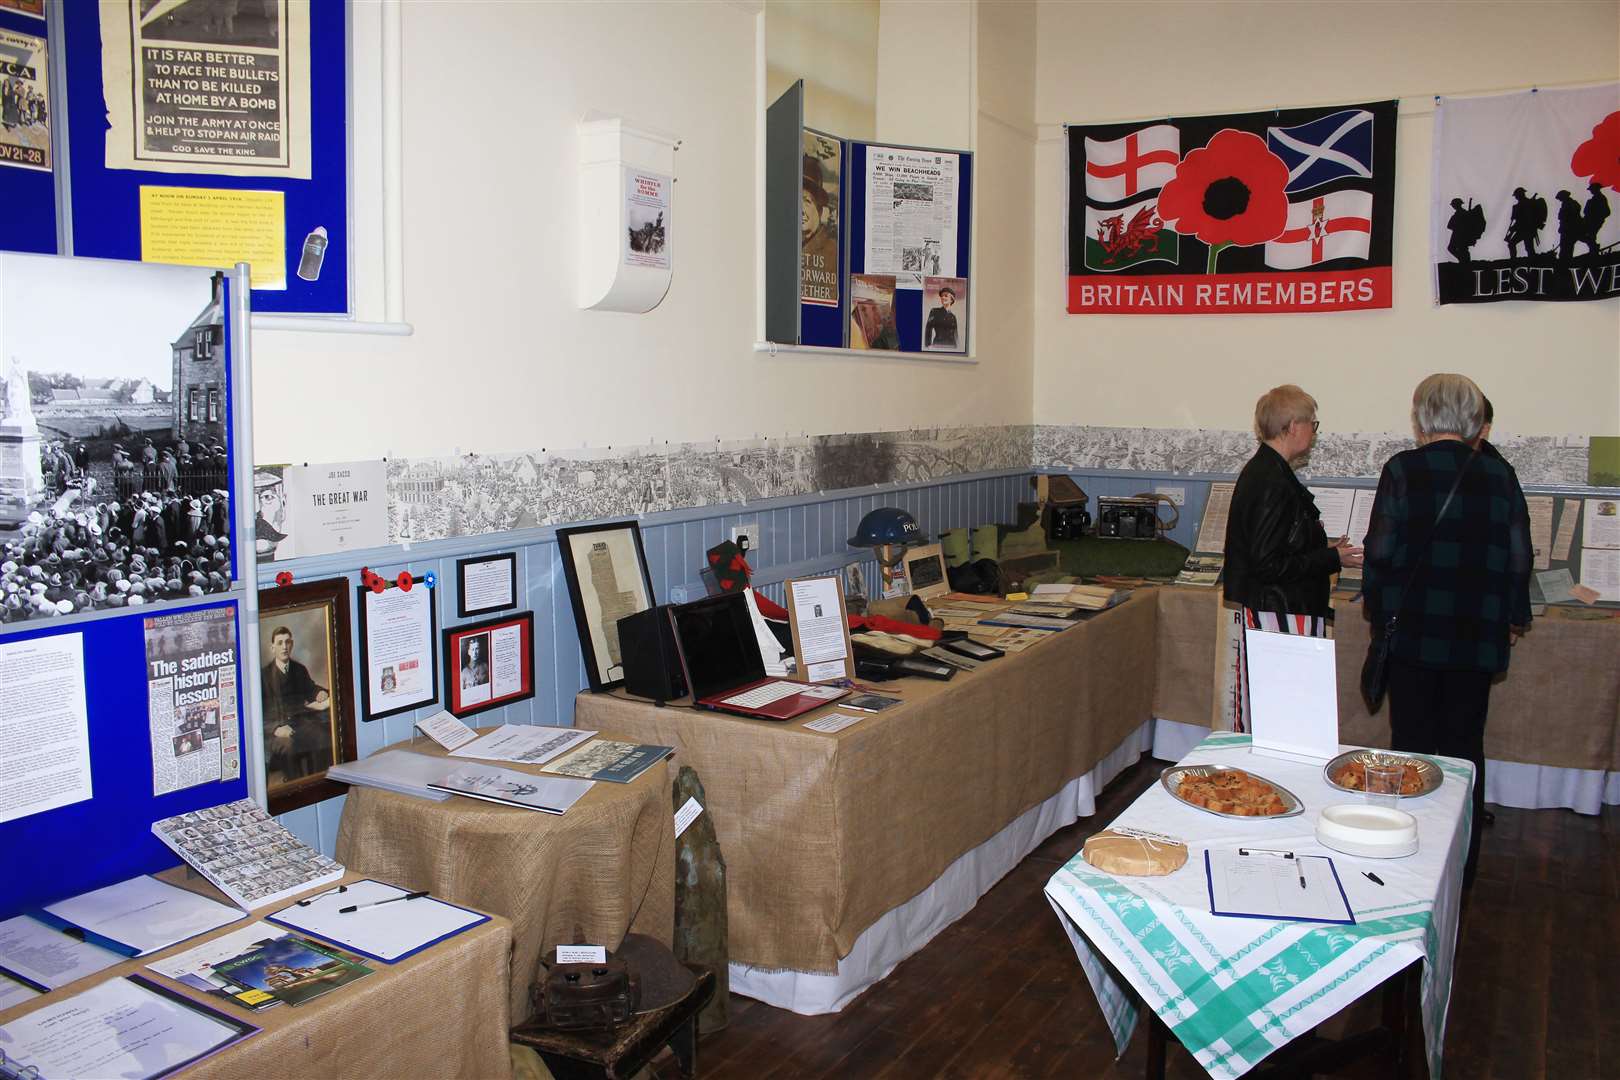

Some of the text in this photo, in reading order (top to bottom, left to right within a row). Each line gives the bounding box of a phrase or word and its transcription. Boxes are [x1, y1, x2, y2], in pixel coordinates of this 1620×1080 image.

[147, 49, 255, 66] IT IS FAR BETTER
[155, 64, 279, 81] TO FACE THE BULLETS
[148, 78, 262, 95] THAN TO BE KILLED
[156, 93, 277, 110] AT HOME BY A BOMB
[146, 115, 280, 131] JOIN THE ARMY AT ONCE
[146, 127, 280, 142] & HELP TO STOP AN AIR RAID
[0, 145, 12, 158] OV
[172, 145, 256, 156] GOD SAVE THE KING
[903, 168, 941, 176] BEACHHEADS
[813, 254, 825, 268] US
[801, 269, 837, 285] ORWARD
[1472, 263, 1620, 297] LEST WE
[1081, 278, 1374, 306] BRITAIN REMEMBERS
[312, 490, 368, 507] THE GREAT WAR
[151, 648, 234, 677] The saddest
[174, 670, 217, 691] history
[175, 686, 218, 707] lesson
